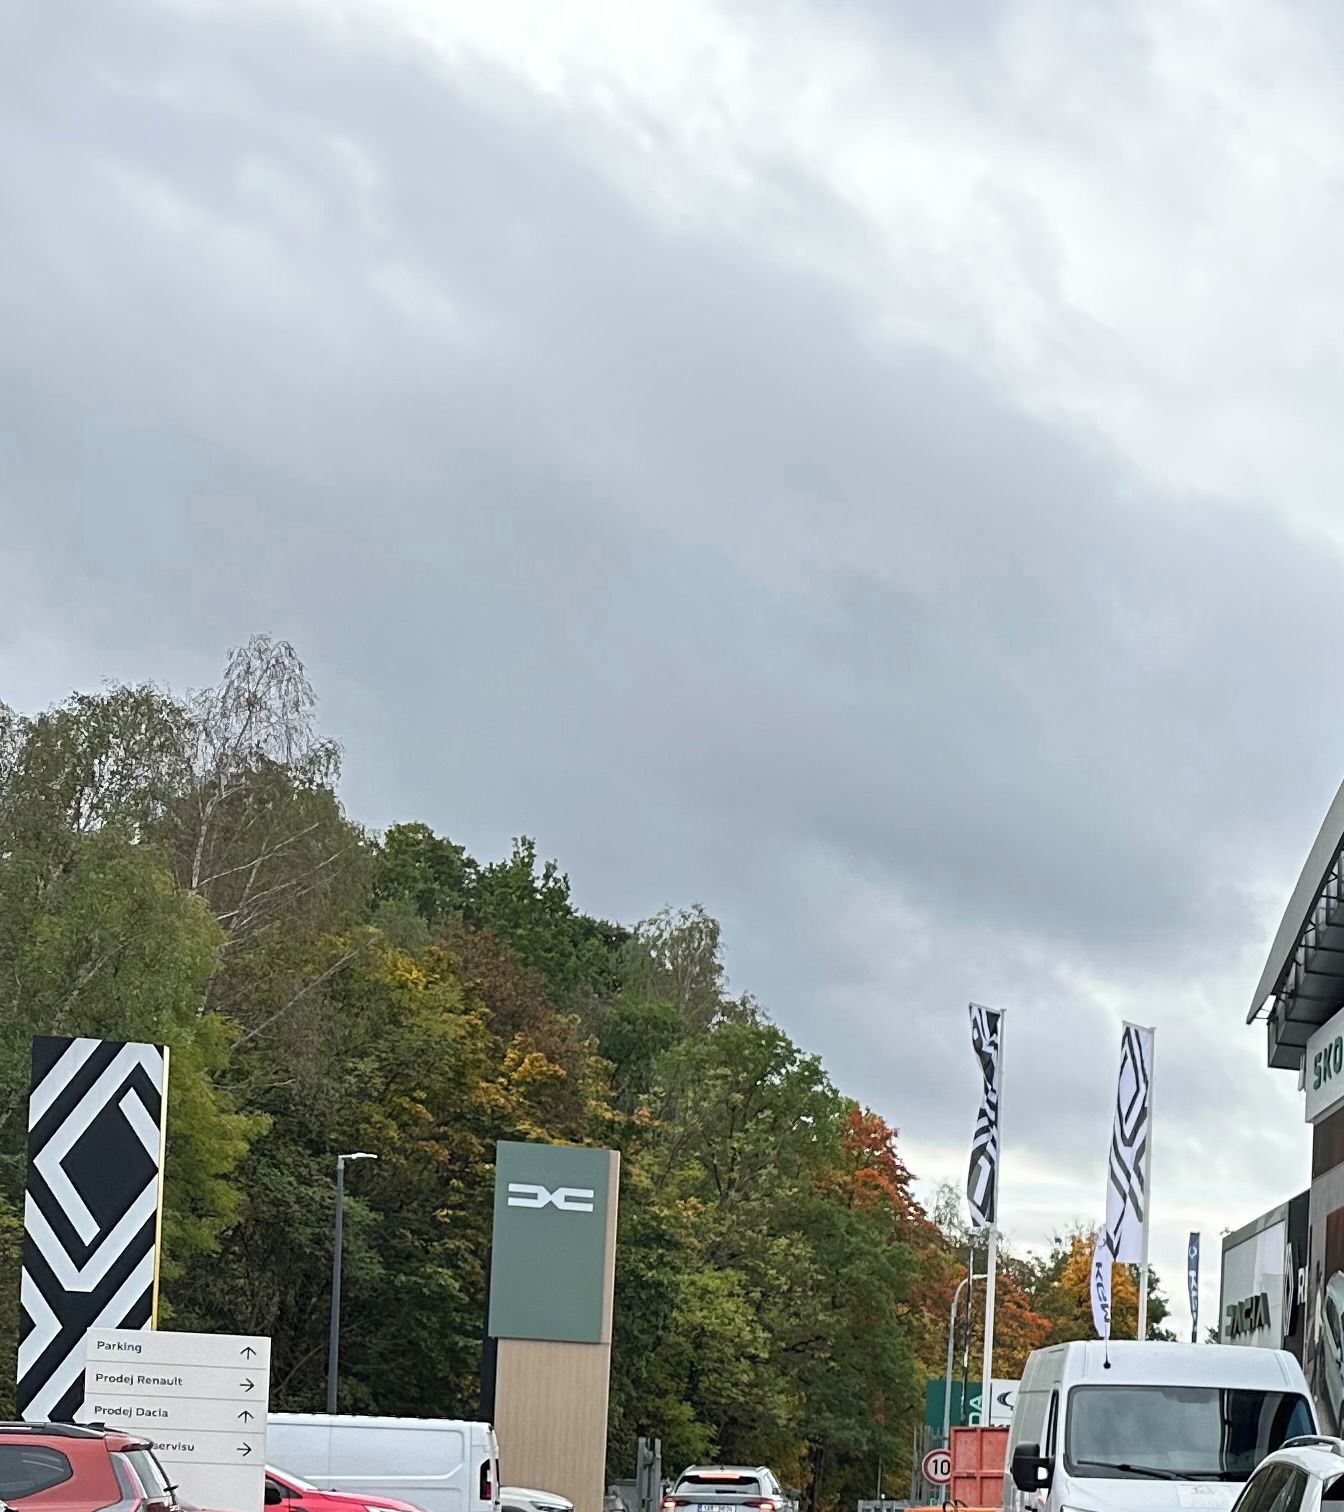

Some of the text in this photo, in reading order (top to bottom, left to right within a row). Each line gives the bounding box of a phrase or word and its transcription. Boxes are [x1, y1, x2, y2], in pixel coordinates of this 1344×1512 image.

[96, 1341, 142, 1354] Parking
[95, 1373, 183, 1386] Prodej Renault
[94, 1406, 169, 1418] Prodej Dacia
[933, 1459, 951, 1476] 10
